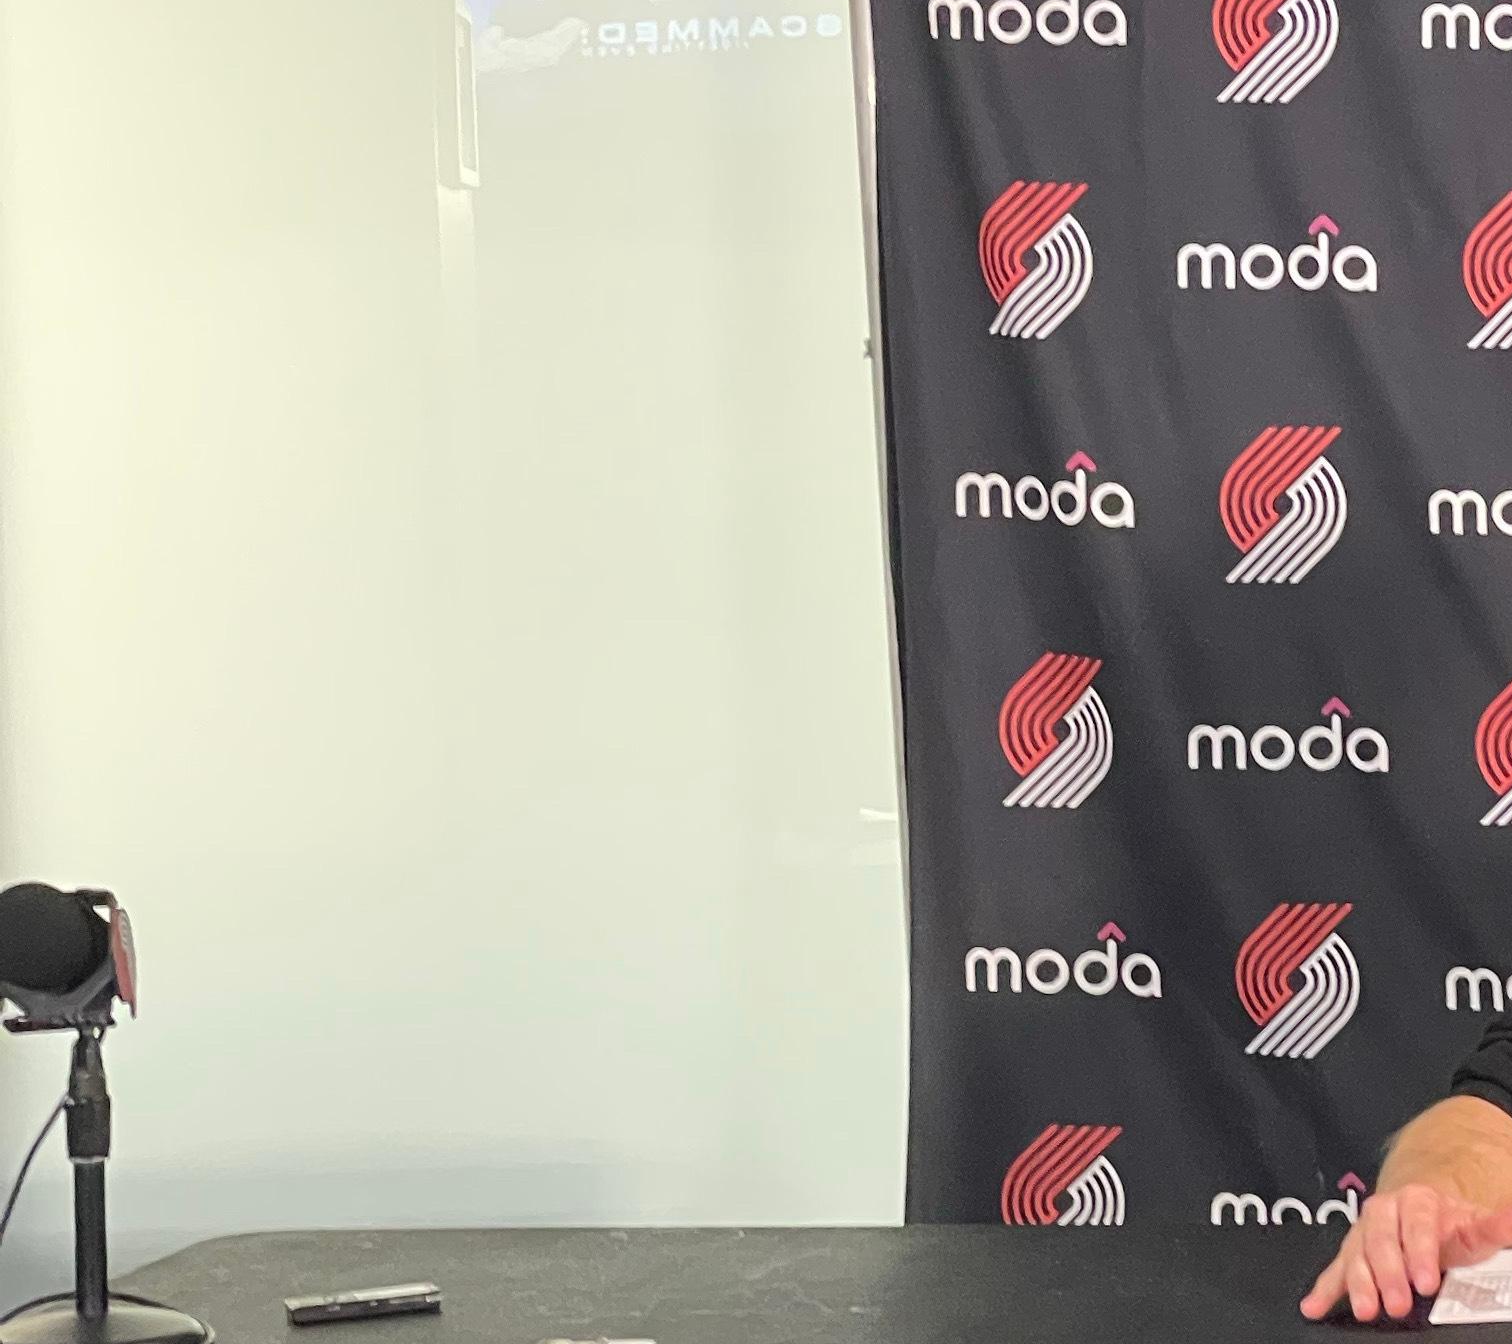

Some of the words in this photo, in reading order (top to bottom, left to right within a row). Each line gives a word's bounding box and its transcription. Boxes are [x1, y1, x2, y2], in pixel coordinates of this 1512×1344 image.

[1177, 215, 1377, 292] moda
[956, 452, 1135, 528] moda
[1188, 699, 1389, 772] moda
[965, 923, 1162, 997] moda
